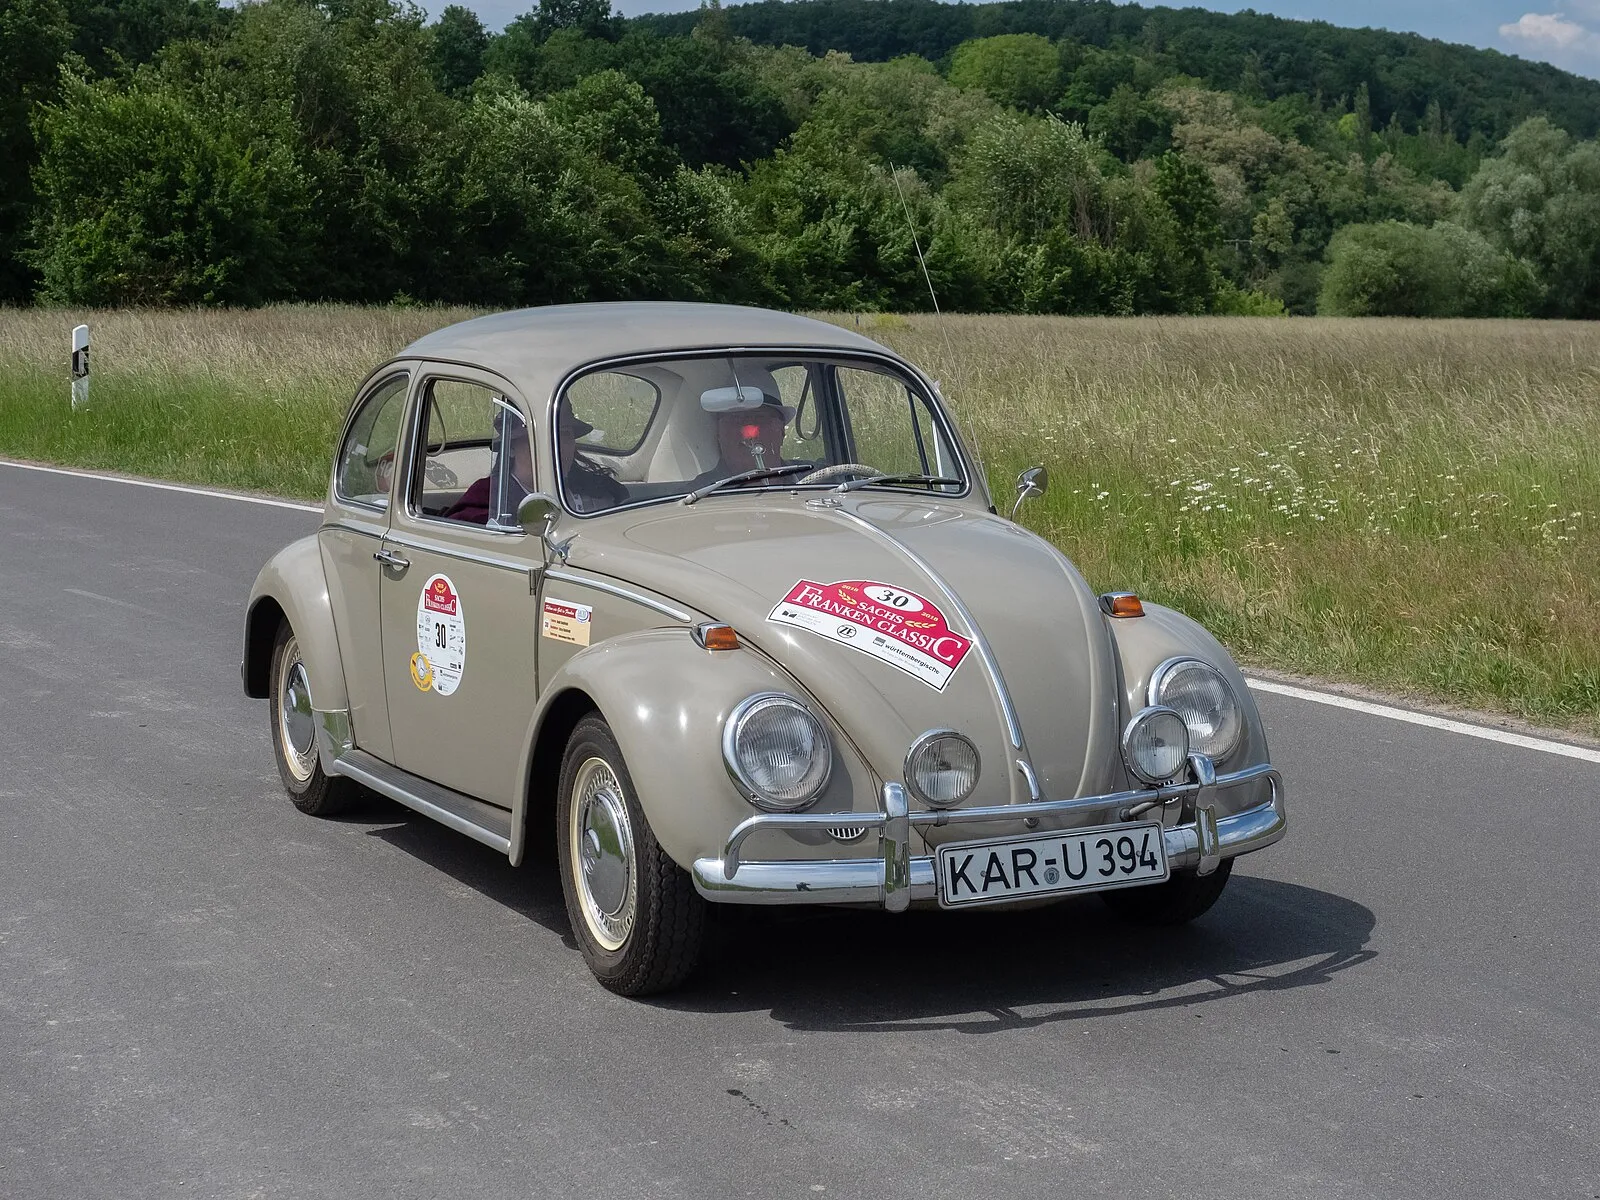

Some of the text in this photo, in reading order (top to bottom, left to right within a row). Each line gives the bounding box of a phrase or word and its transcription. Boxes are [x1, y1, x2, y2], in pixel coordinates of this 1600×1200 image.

[877, 589, 909, 608] 30
[792, 585, 877, 625] FRANKEN
[877, 620, 963, 661] CLASSIC
[857, 602, 905, 623] SACHS
[435, 622, 446, 649] 30
[839, 627, 855, 636] ZF
[885, 643, 940, 675] württembergische
[949, 833, 1158, 896] KAR-U 394
